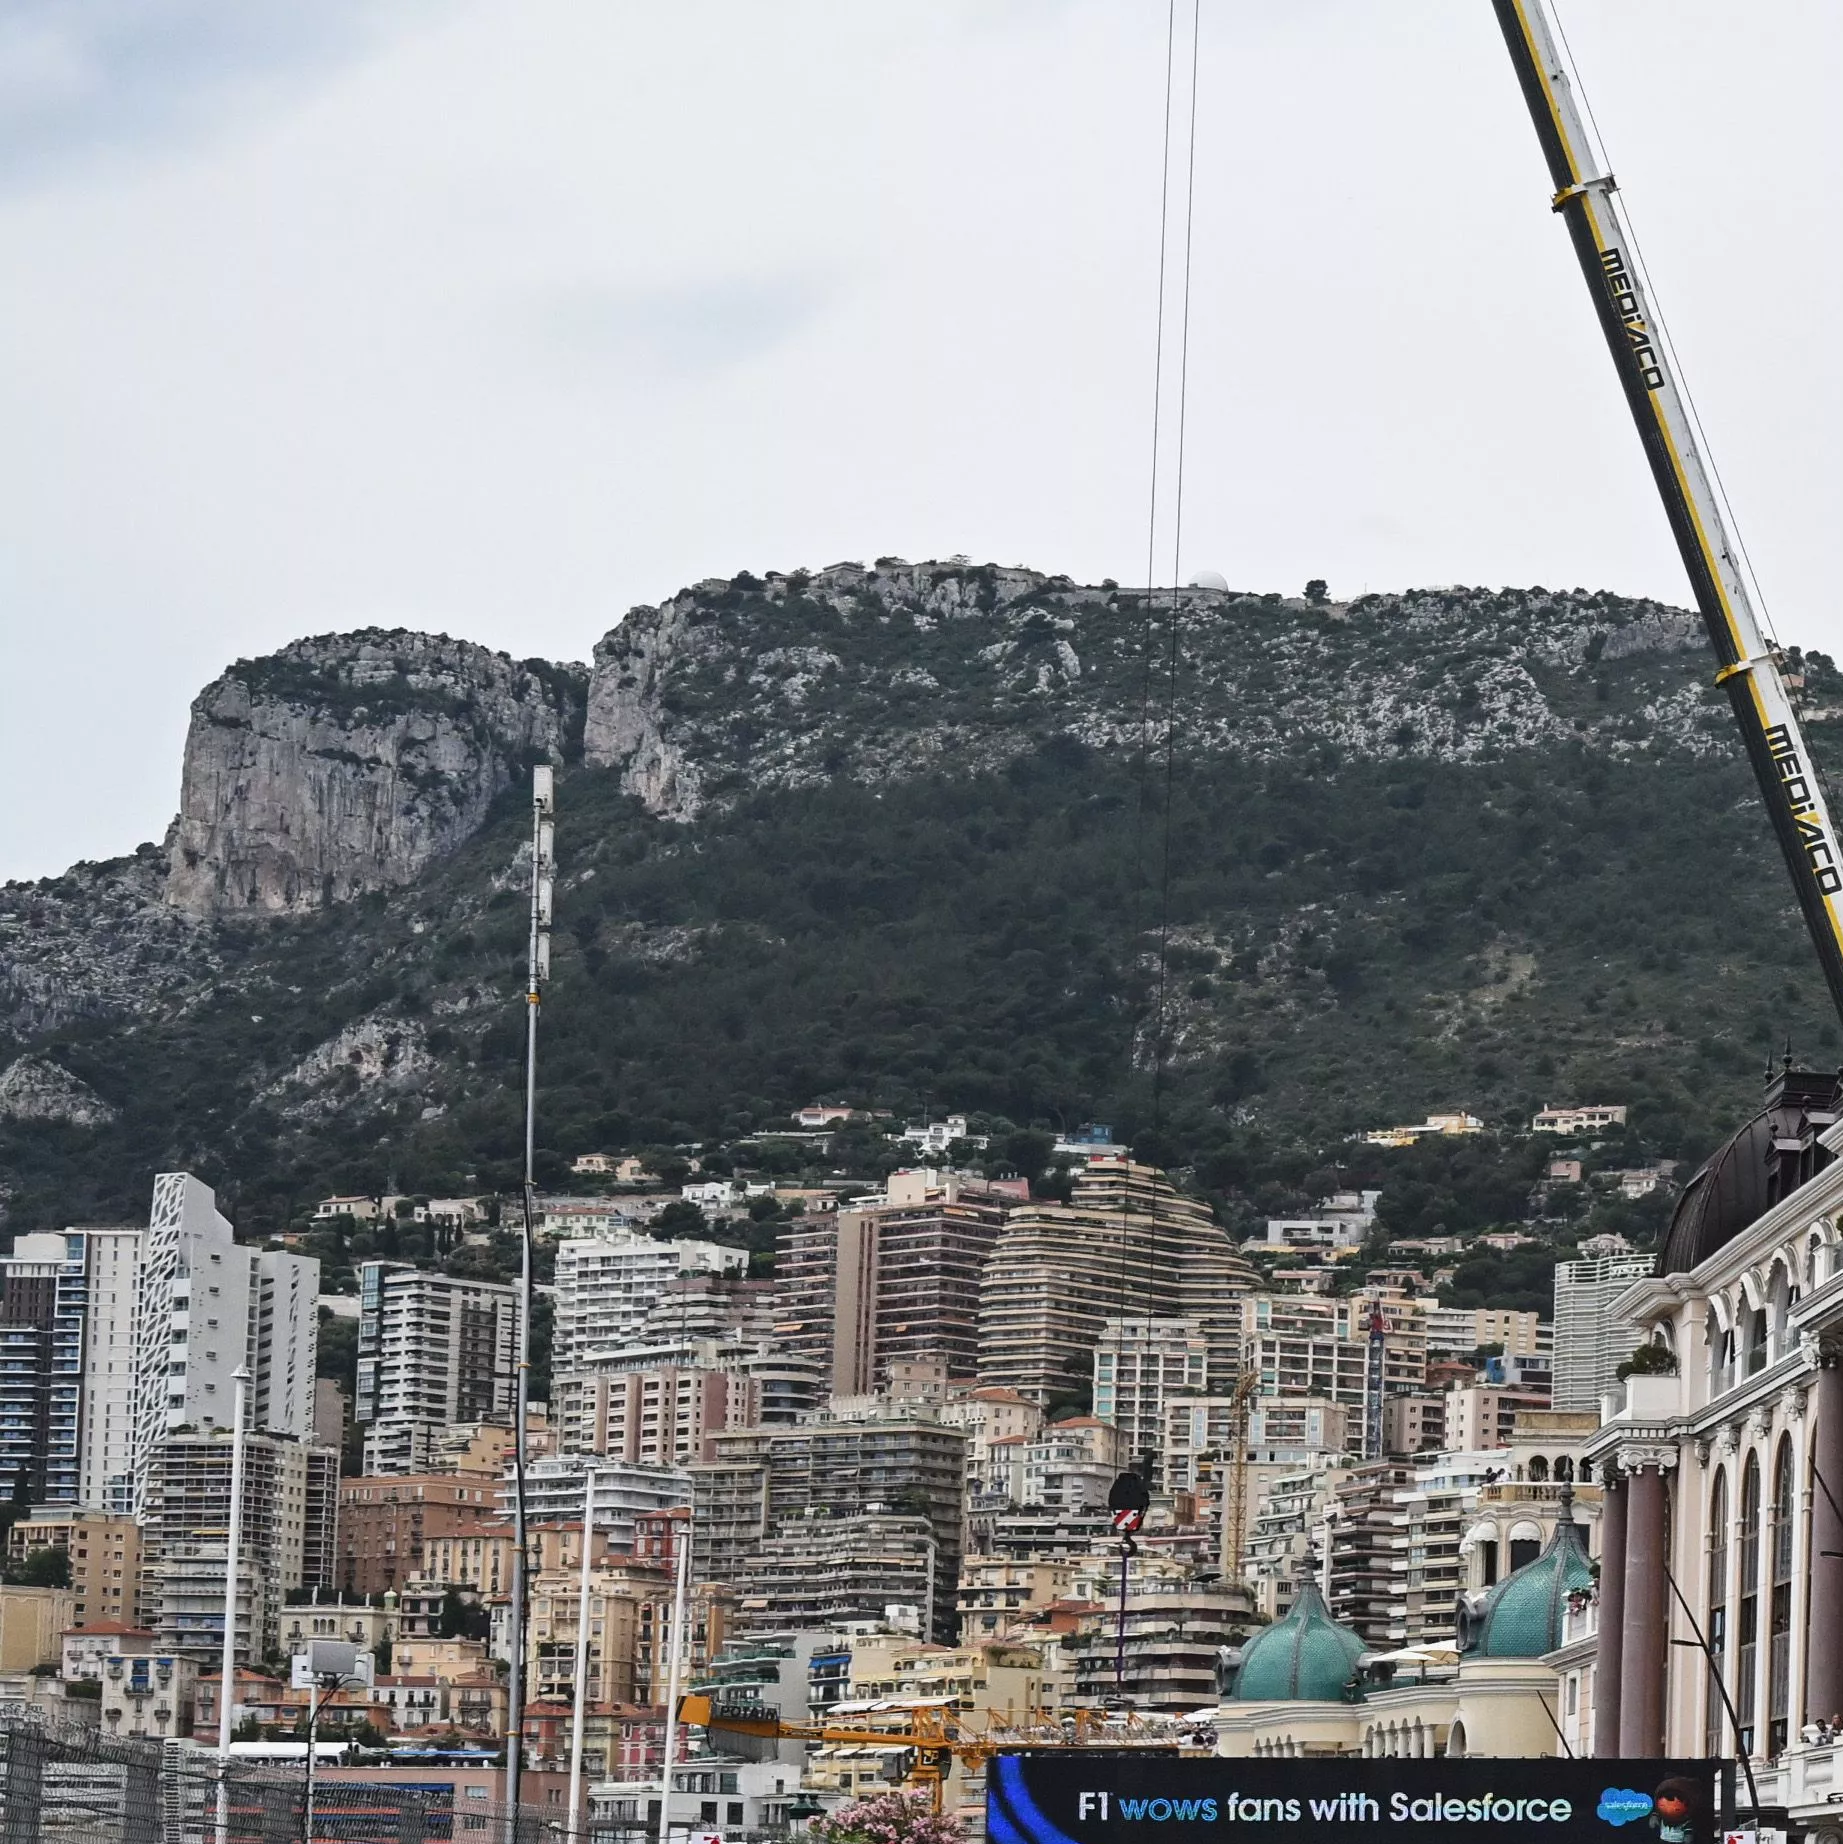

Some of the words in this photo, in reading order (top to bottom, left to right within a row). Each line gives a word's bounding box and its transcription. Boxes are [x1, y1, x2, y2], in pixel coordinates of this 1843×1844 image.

[1078, 1791, 1109, 1822] F1
[1118, 1798, 1218, 1822] wows
[1228, 1791, 1302, 1822] fans
[1309, 1791, 1380, 1822] with
[1389, 1791, 1573, 1823] Salesforce
